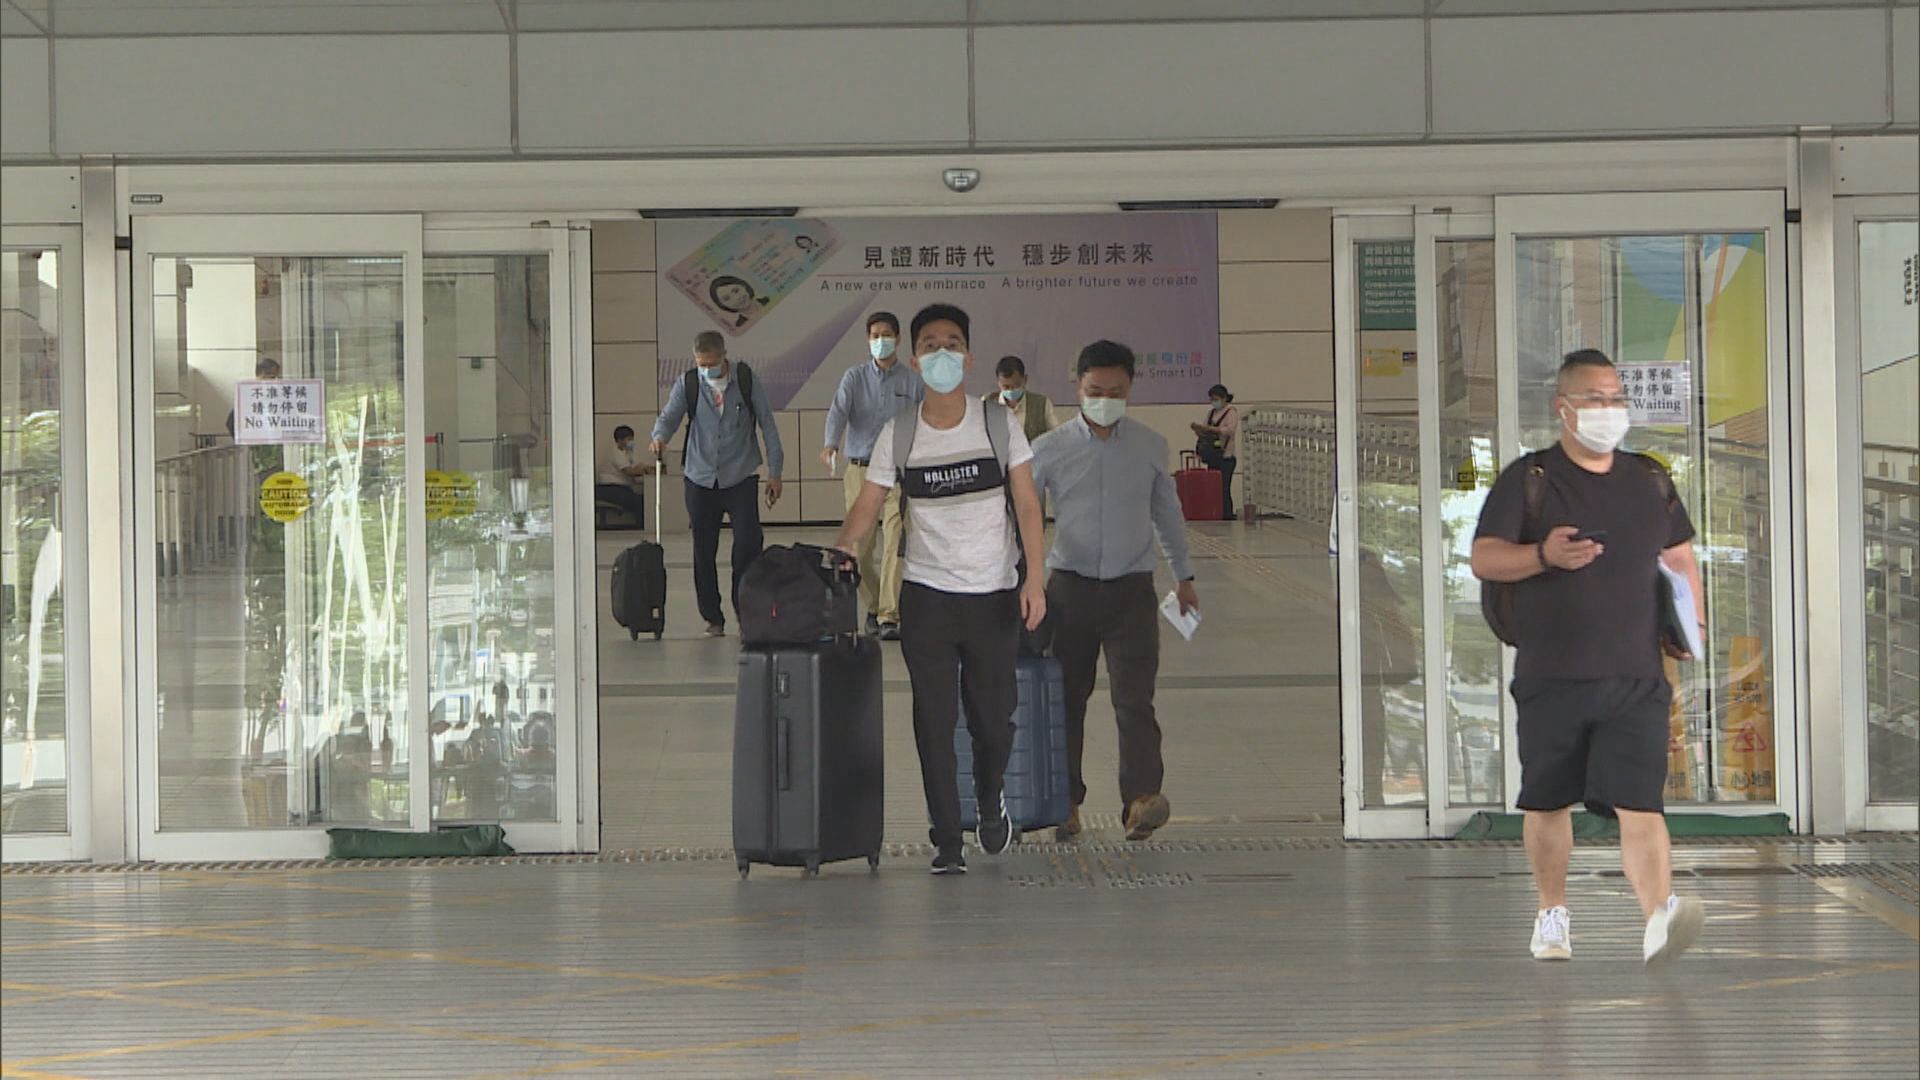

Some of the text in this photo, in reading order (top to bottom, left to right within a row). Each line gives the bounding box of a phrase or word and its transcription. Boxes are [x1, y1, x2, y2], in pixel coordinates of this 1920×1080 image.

[864, 242, 1154, 269] 見證新時代 穩步創未來
[820, 275, 1198, 292] A new era we embrace A brighter future we create
[1149, 367, 1185, 378] Smart
[1189, 366, 1204, 377] ID
[251, 386, 307, 400] 不准等候
[251, 401, 308, 415] 請勿停留
[1633, 398, 1681, 412] Waiting
[245, 415, 316, 430] No Waiting
[924, 464, 979, 484] HOLLISTER
